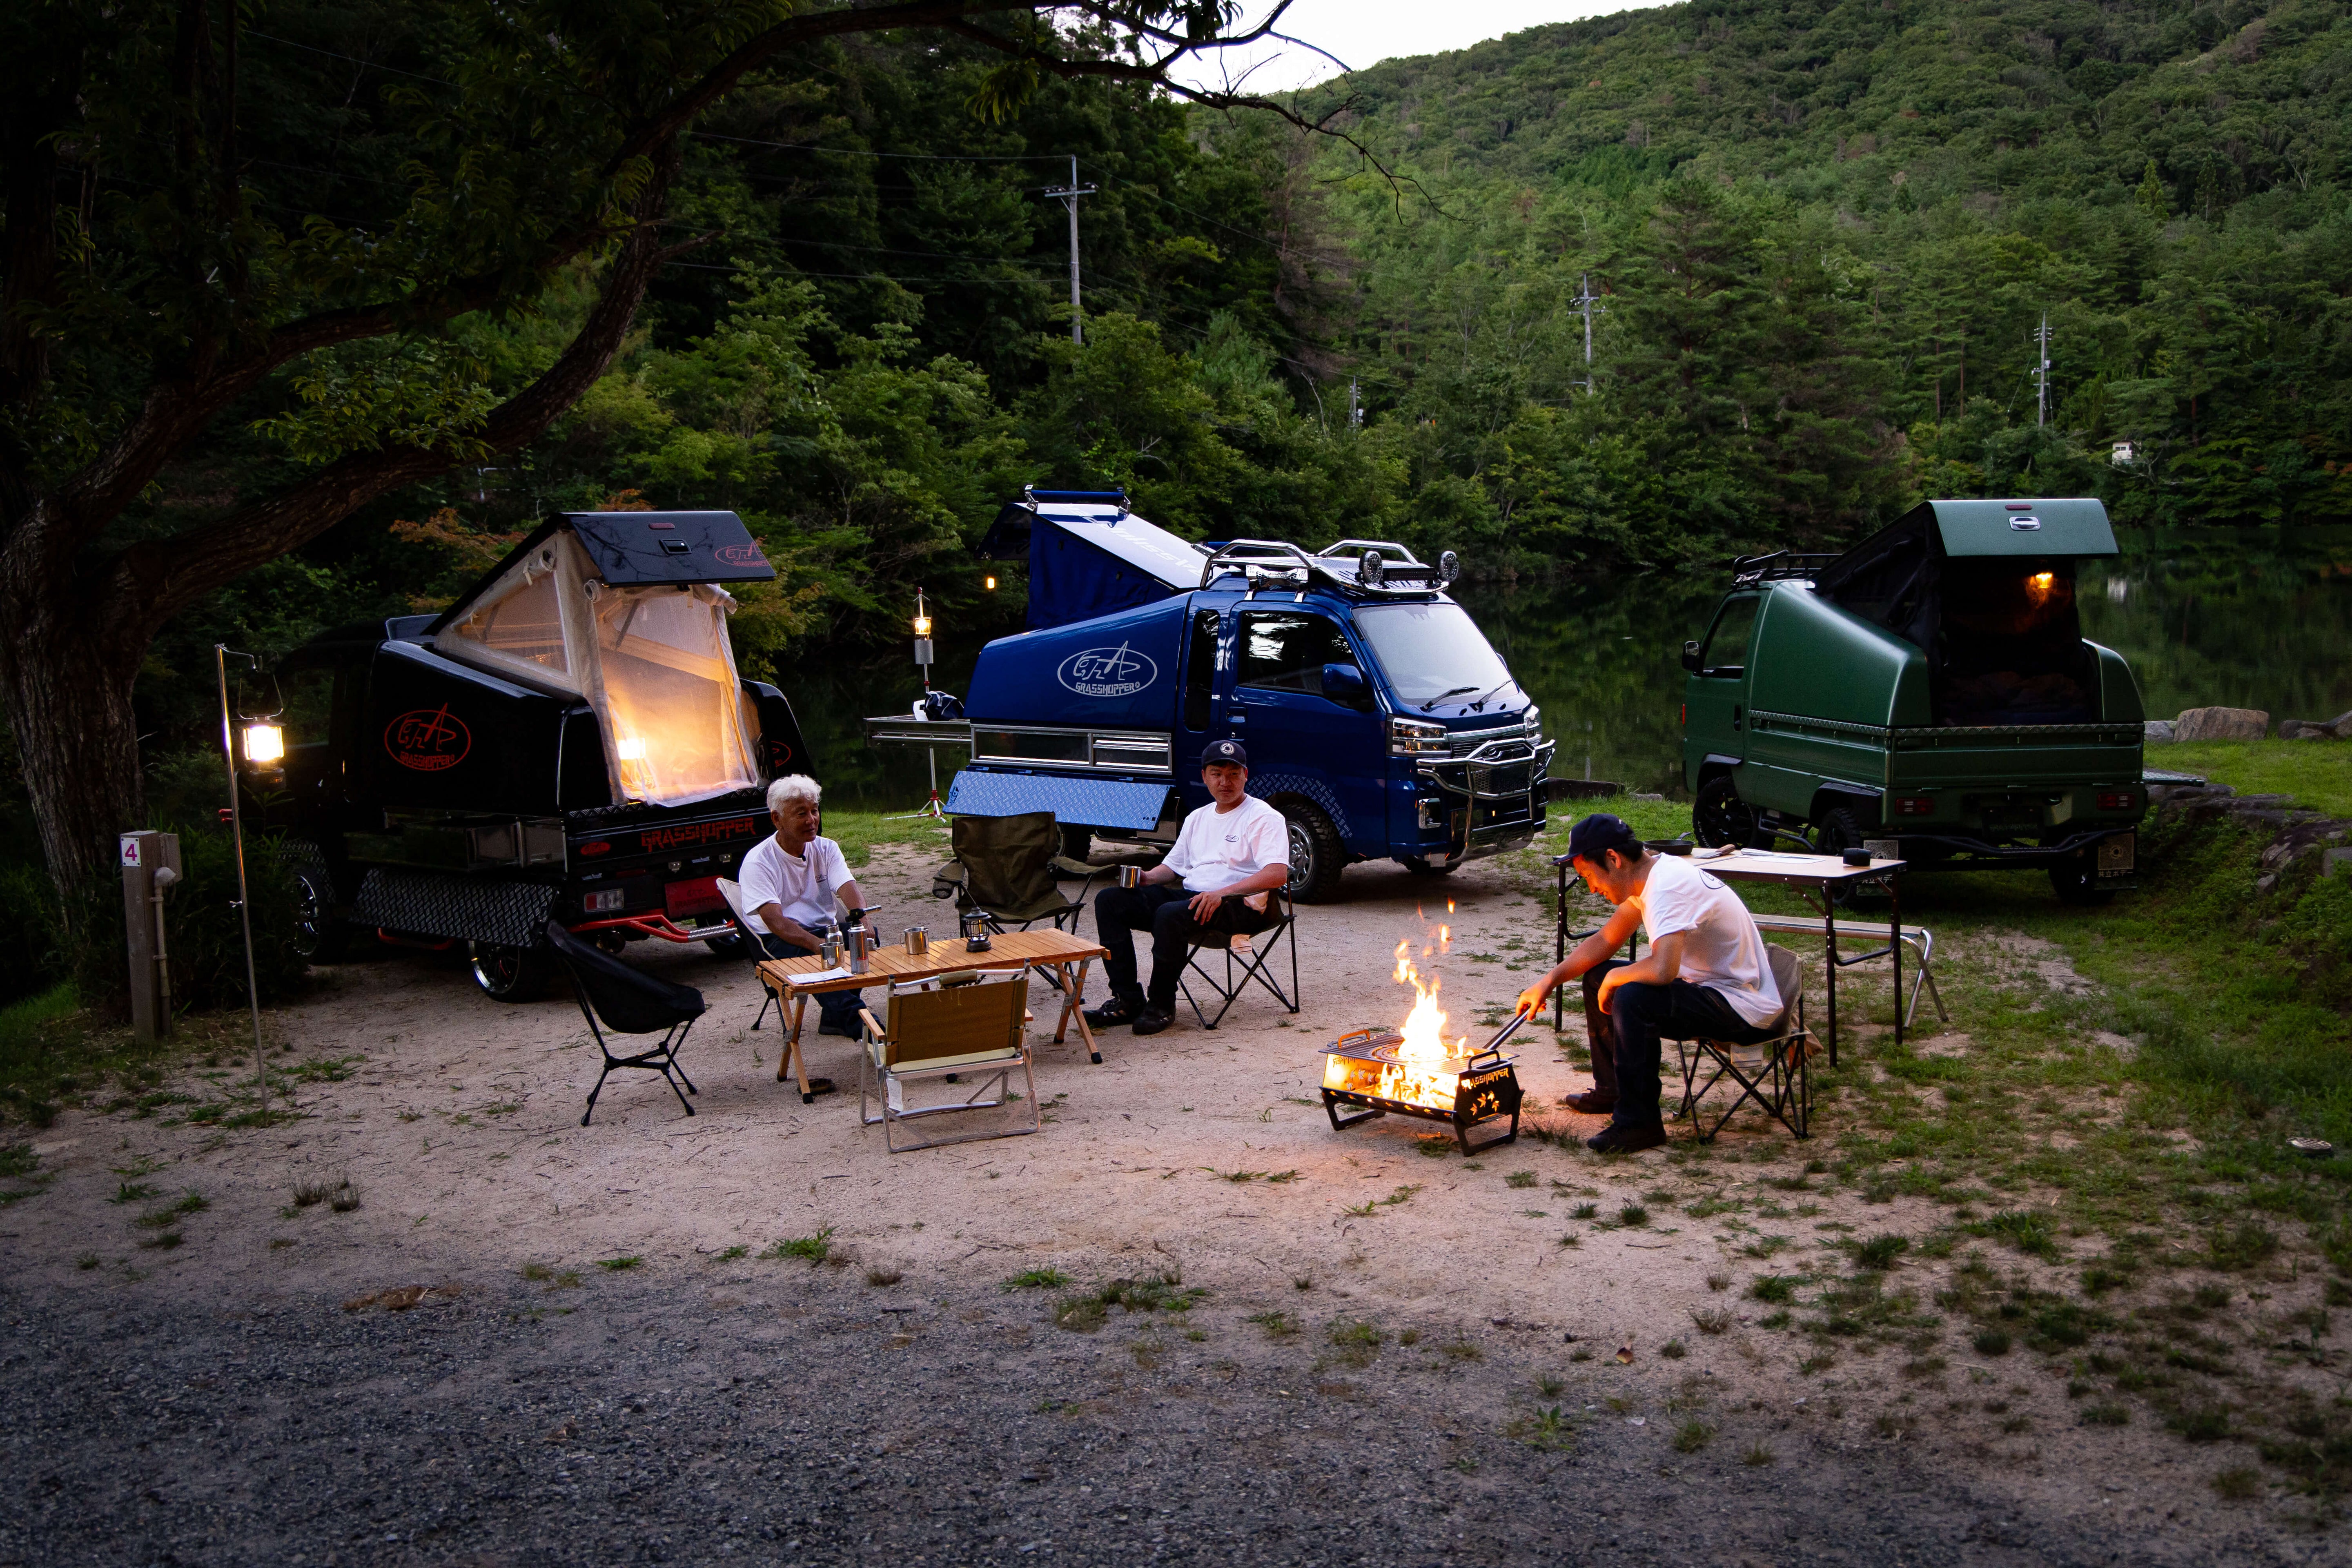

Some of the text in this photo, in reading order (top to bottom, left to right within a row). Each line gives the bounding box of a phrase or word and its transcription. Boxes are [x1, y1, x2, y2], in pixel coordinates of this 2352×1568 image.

[1076, 682, 1134, 695] GRASSHOPPER
[399, 751, 450, 768] GRASSHOPPER
[641, 817, 756, 852] GRASSHOPPER
[125, 844, 137, 861] 4
